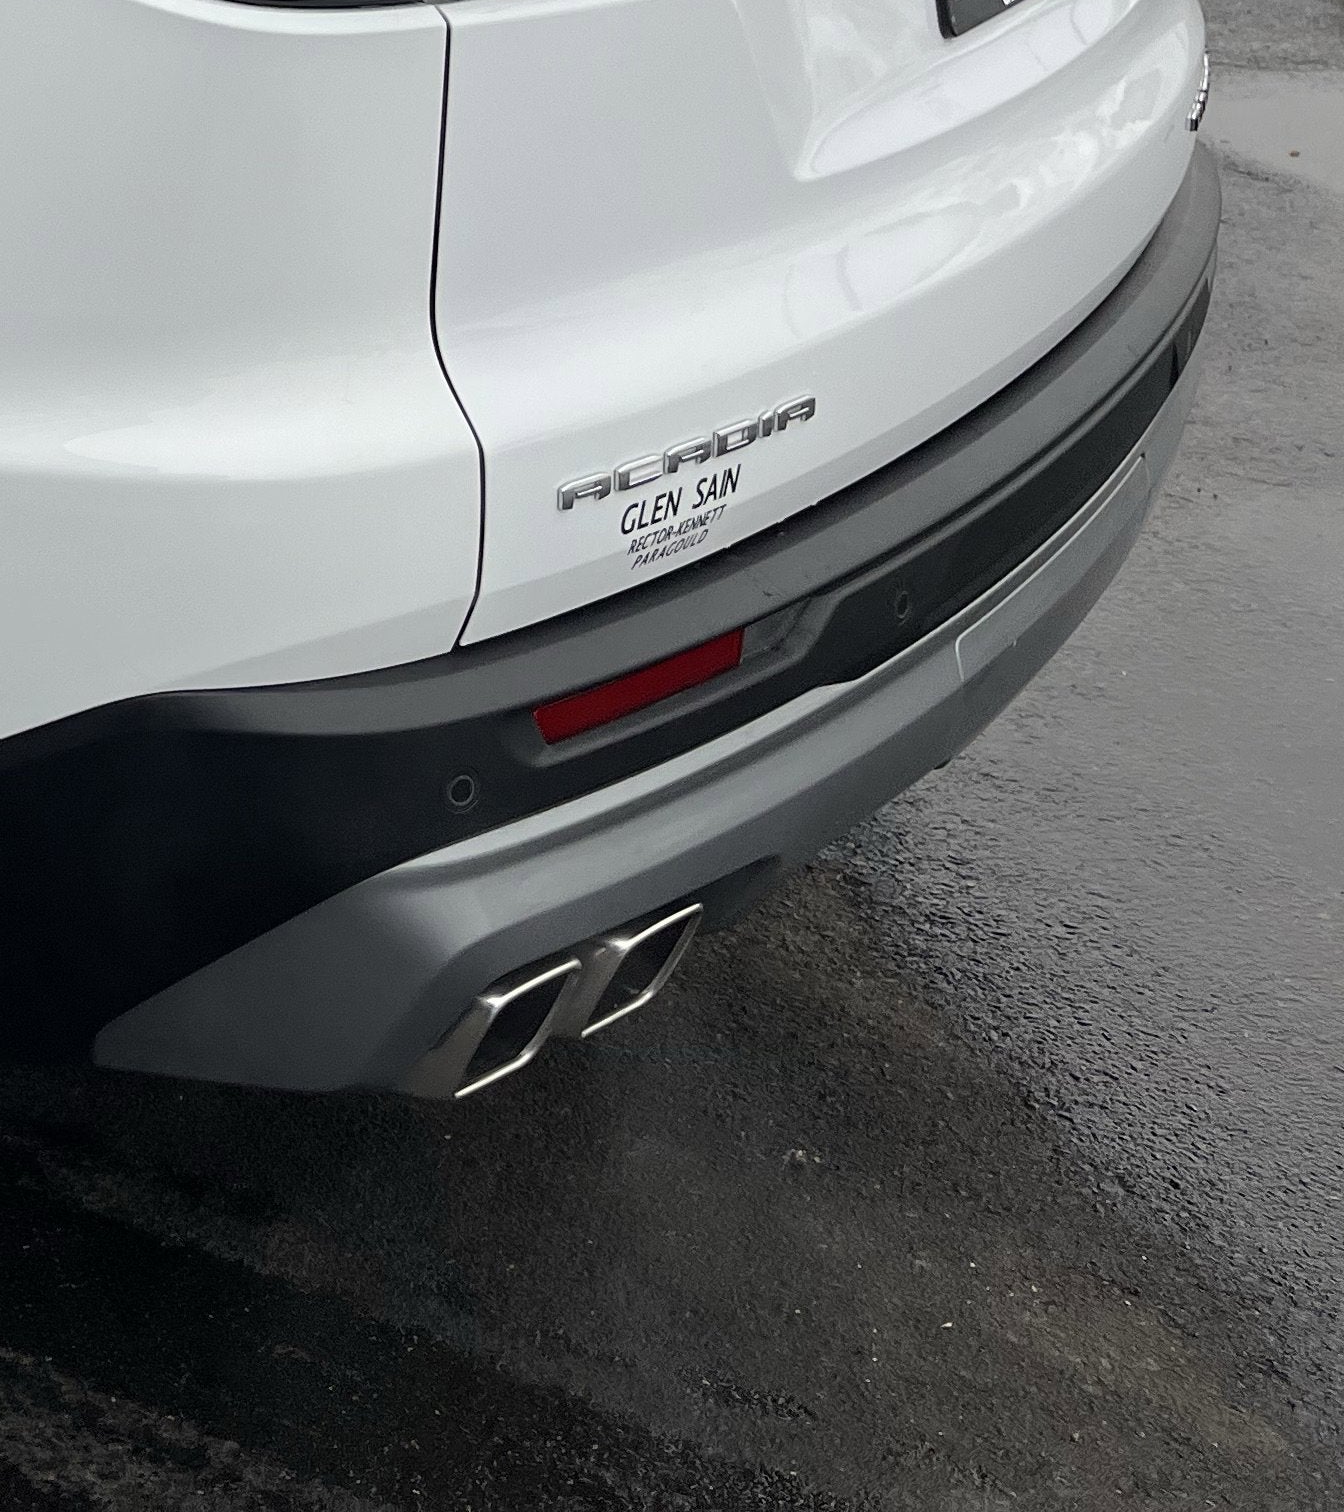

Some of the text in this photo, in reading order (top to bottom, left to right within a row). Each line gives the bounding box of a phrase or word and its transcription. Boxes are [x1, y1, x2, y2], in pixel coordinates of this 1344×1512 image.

[557, 393, 816, 511] ACADIA
[620, 464, 741, 535] GLEN SAIN
[631, 529, 709, 570] PARAGOULD
